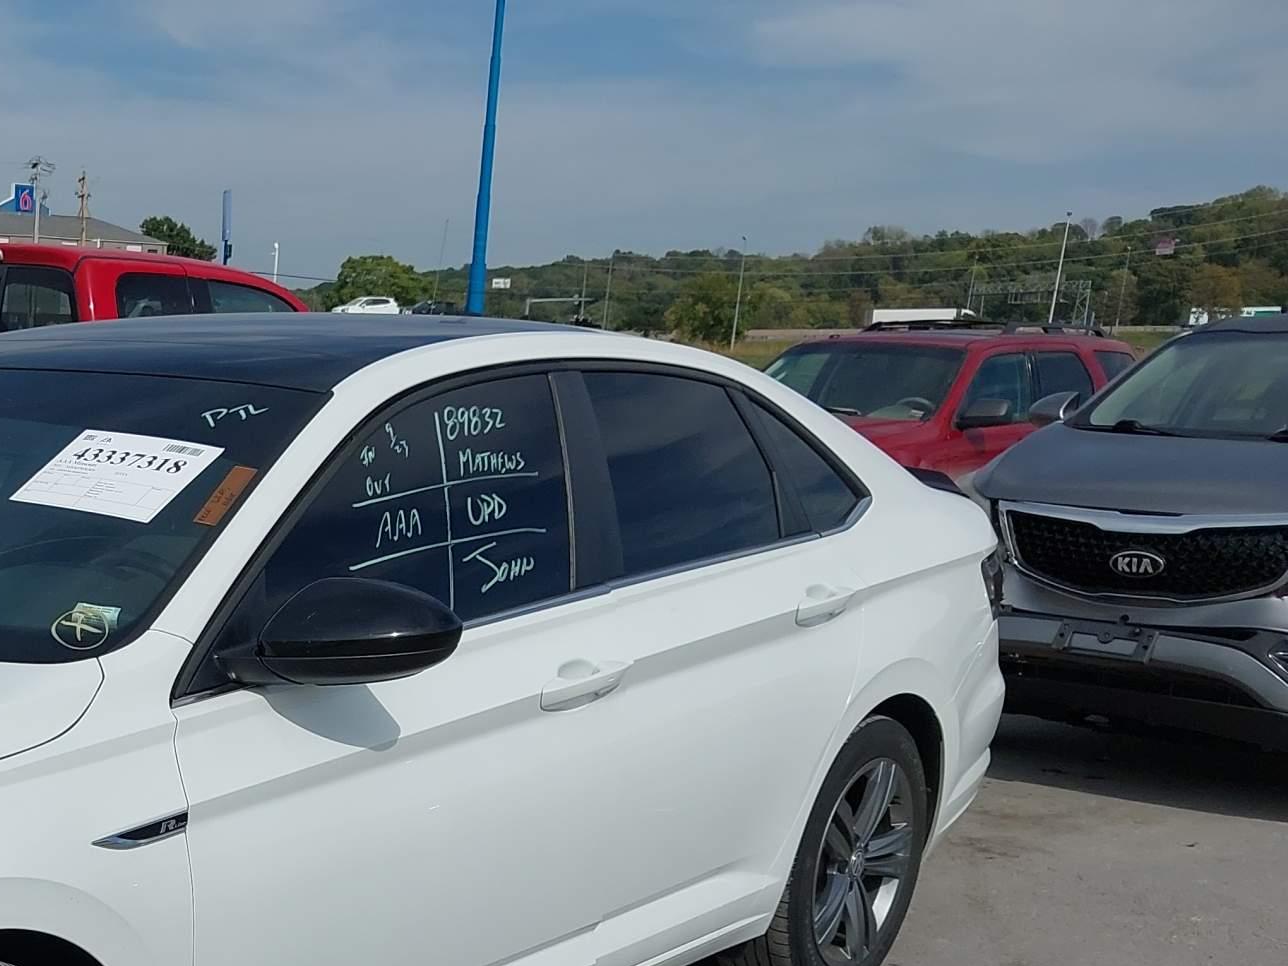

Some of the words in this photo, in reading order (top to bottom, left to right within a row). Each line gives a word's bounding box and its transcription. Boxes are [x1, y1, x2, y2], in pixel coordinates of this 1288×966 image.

[20, 188, 32, 211] 6
[444, 406, 506, 441] 89832
[71, 446, 189, 475] 43337318
[366, 472, 391, 497] OUT
[467, 493, 508, 526] UPD
[375, 507, 423, 549] AAA
[462, 541, 535, 594] JOHN
[1117, 556, 1154, 574] KIA
